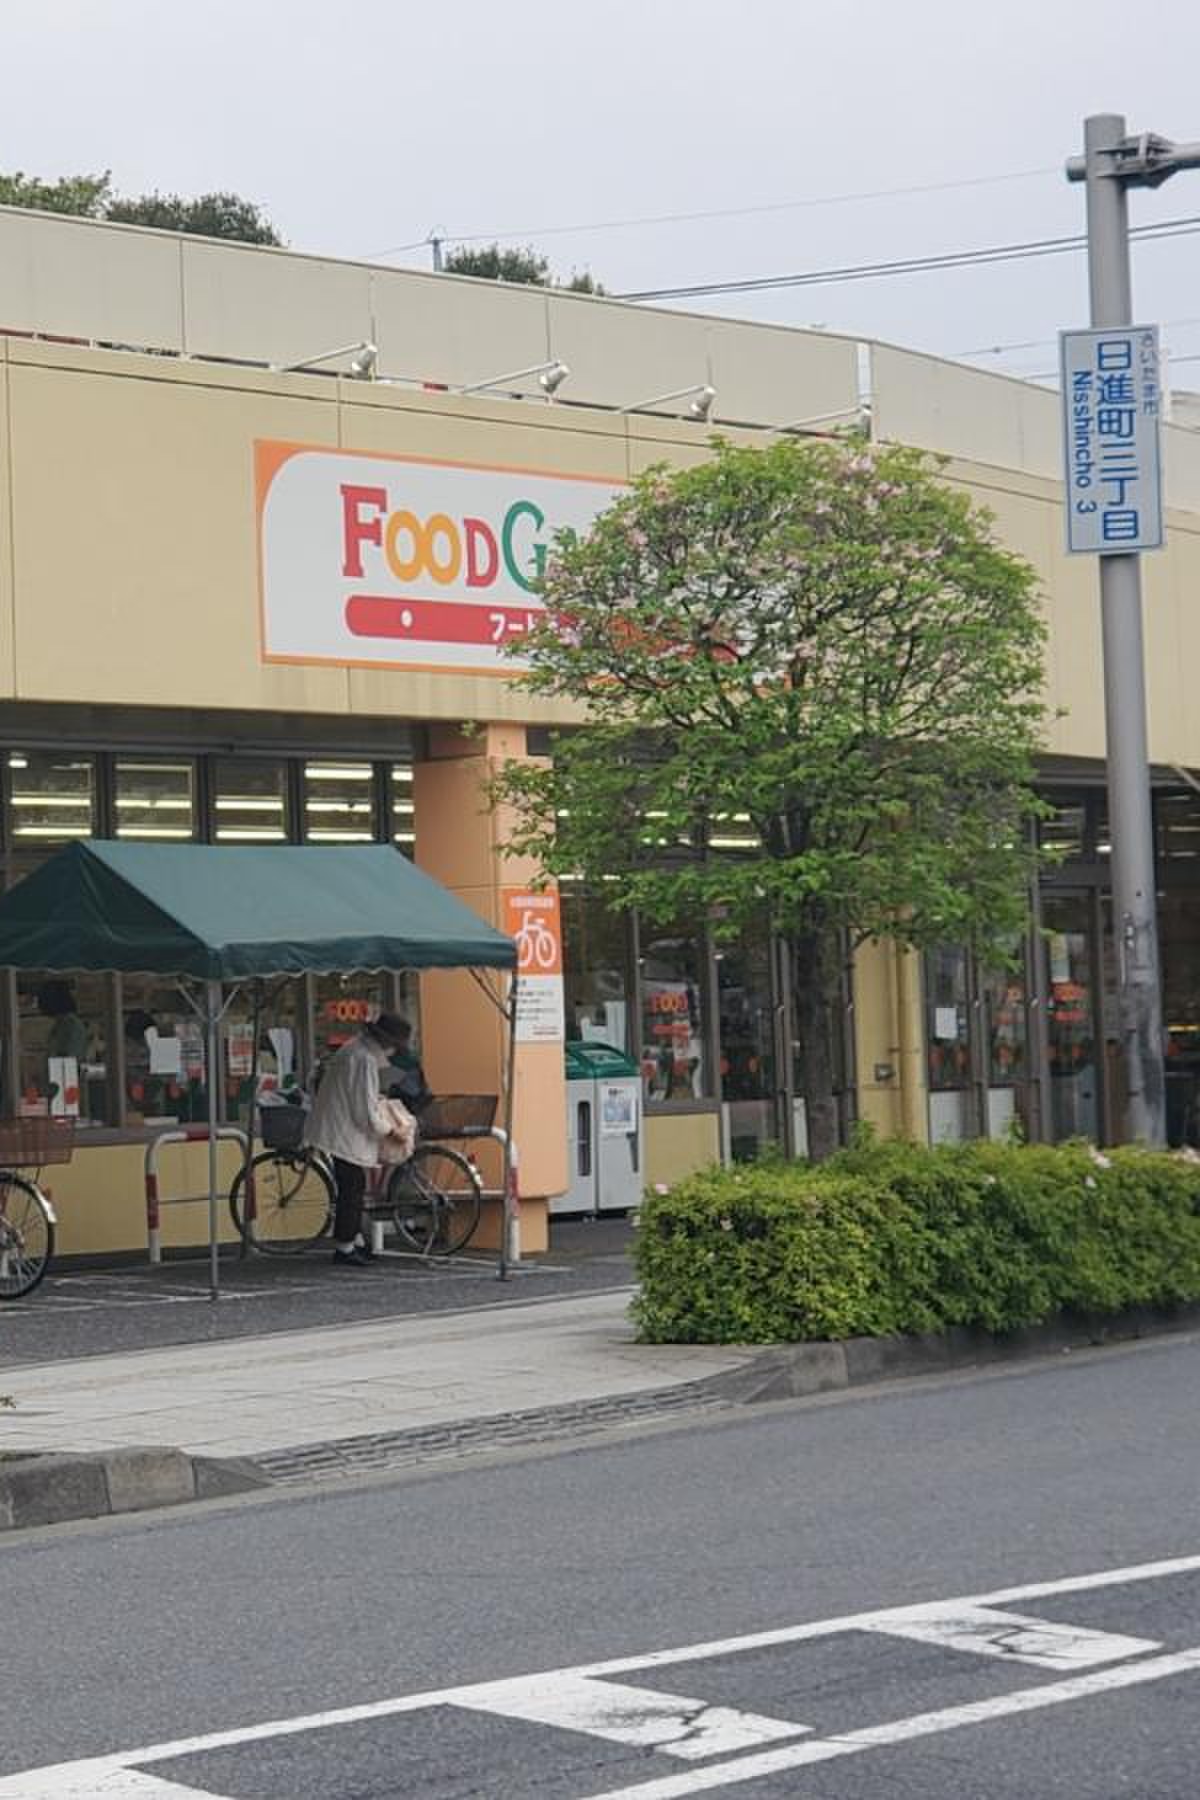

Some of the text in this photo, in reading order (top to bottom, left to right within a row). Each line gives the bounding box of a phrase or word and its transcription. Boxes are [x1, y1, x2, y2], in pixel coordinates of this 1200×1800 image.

[1072, 371, 1097, 514] Nisshincho 3
[1098, 340, 1139, 541] 日進町三丁目
